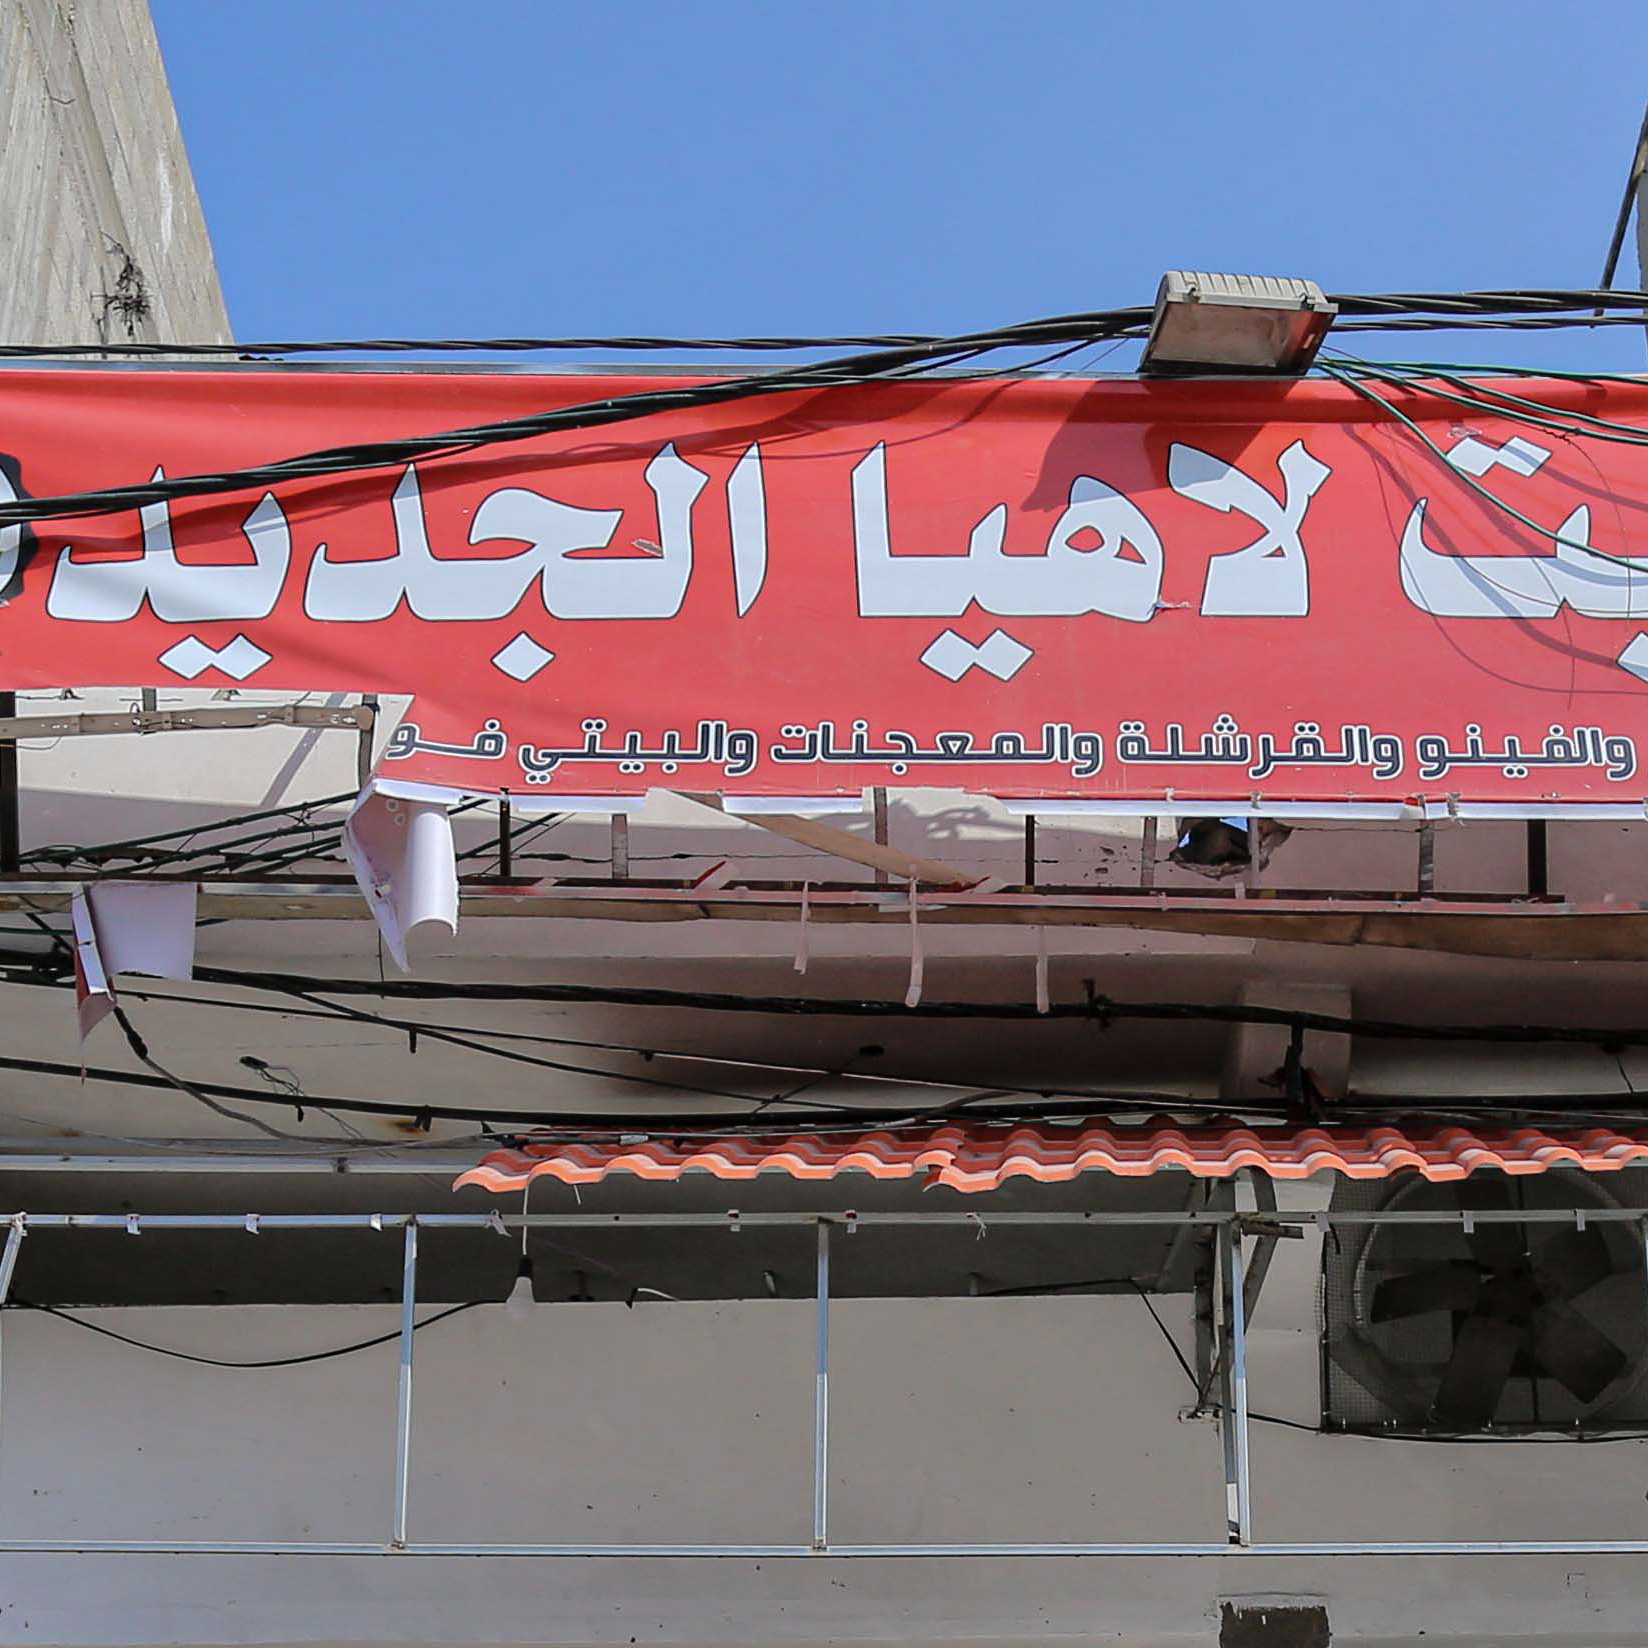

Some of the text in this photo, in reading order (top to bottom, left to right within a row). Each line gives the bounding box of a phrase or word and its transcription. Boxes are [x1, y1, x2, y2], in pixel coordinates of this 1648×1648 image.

[46, 441, 769, 683] الجديد
[850, 439, 1333, 683] لاهيا
[518, 718, 757, 785] والبيتي
[768, 719, 1104, 777] والمعجنات
[1115, 713, 1403, 780] والقرشلة
[1417, 720, 1636, 781] والفينو
